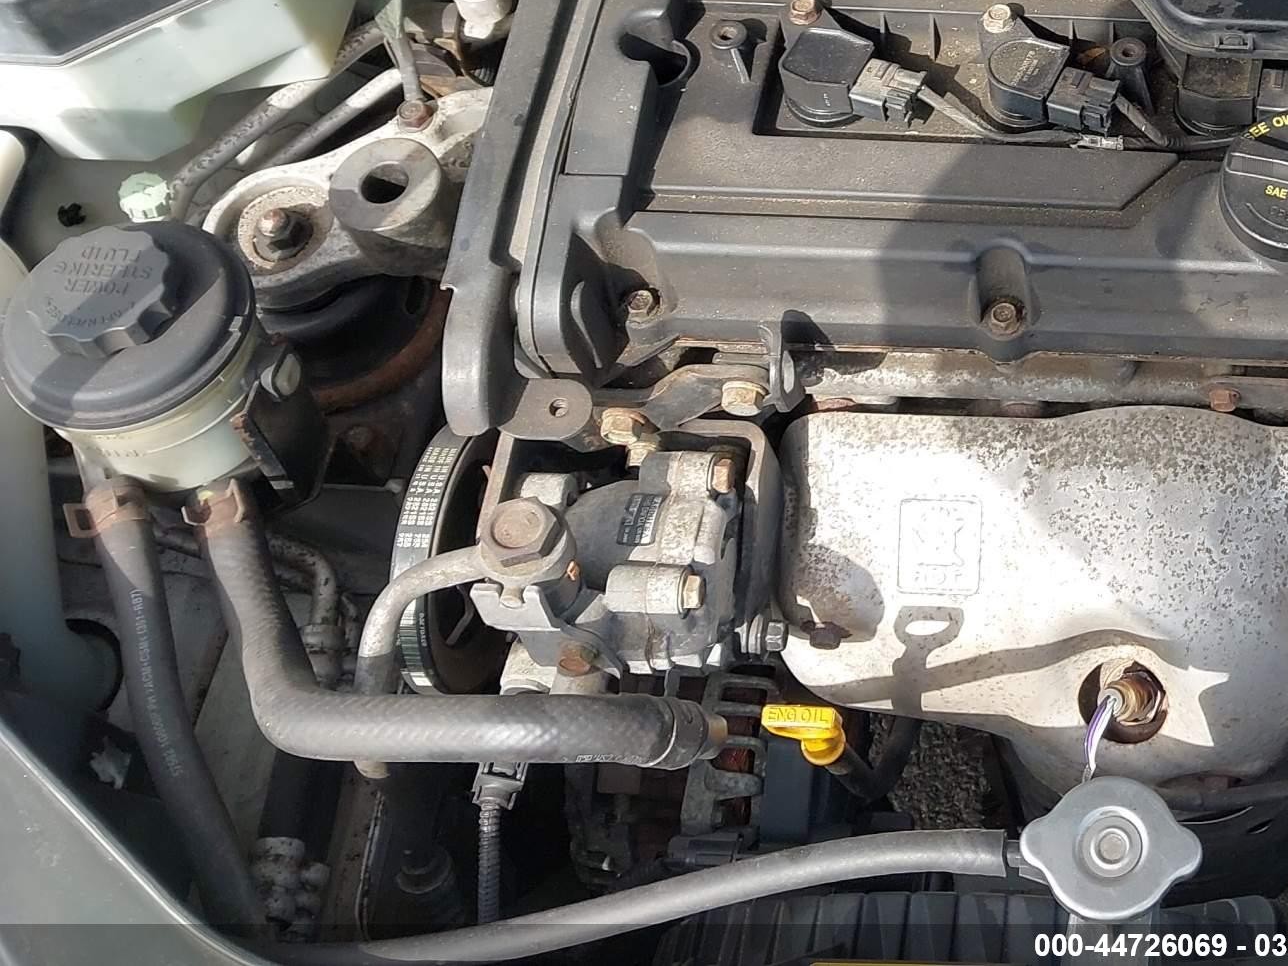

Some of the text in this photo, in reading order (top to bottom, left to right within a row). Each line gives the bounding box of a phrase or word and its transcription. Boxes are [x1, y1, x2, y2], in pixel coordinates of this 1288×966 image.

[1265, 184, 1288, 200] SAE
[80, 246, 143, 263] FLUID
[64, 278, 130, 296] POWER
[767, 707, 829, 724] ENG OIL
